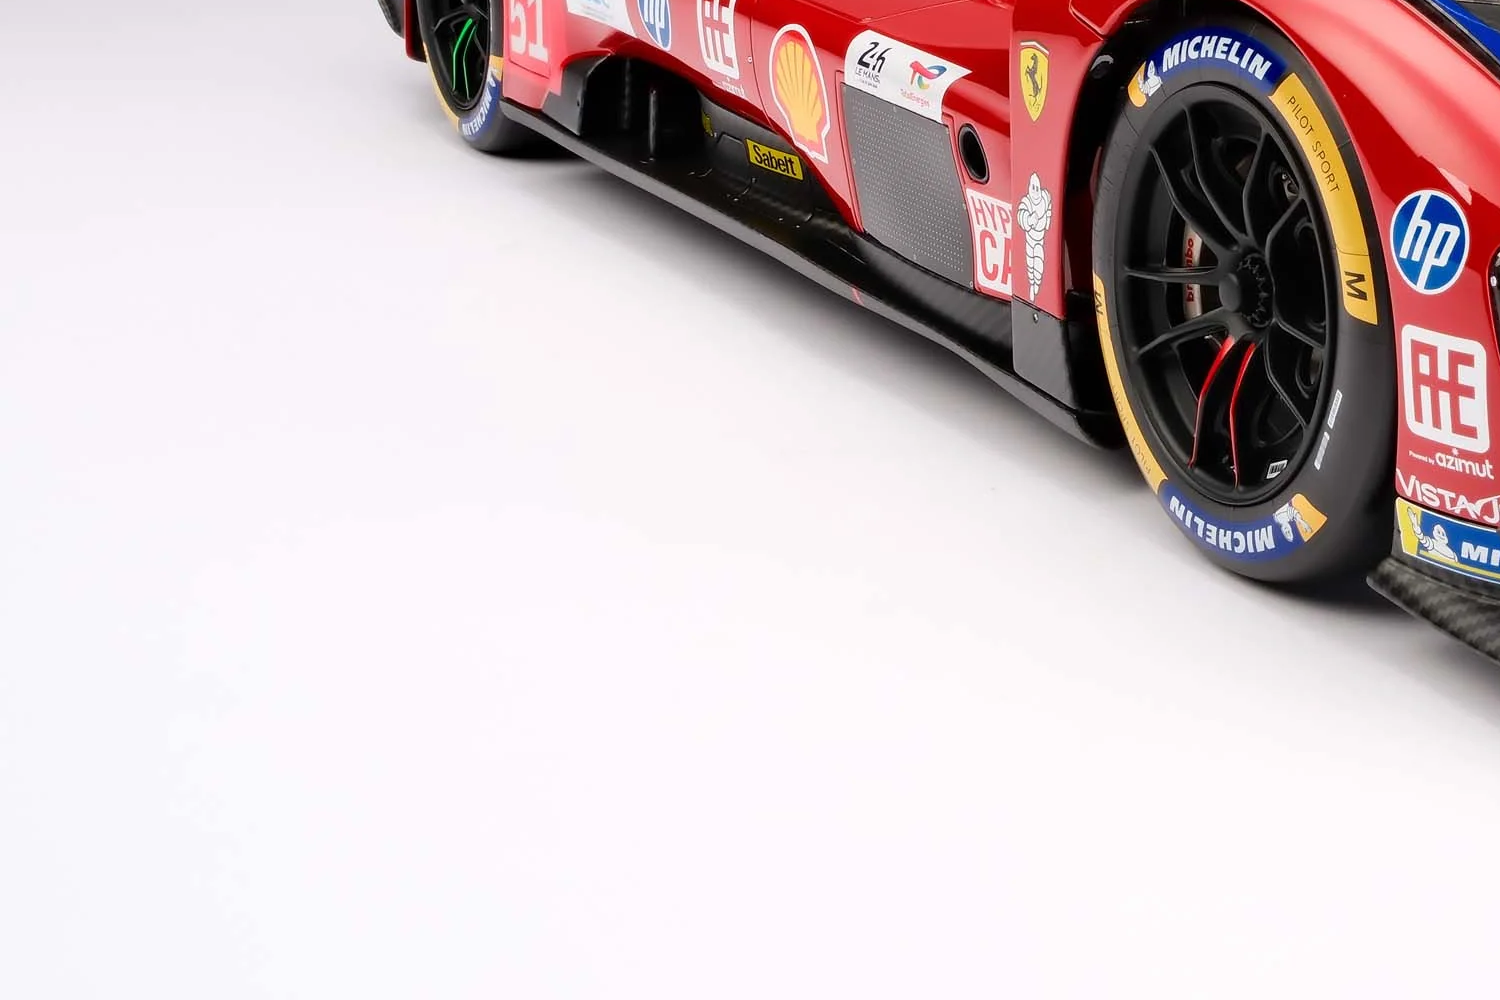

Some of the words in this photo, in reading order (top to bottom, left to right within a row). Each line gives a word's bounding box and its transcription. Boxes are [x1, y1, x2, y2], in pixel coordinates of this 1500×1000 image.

[1162, 35, 1272, 81] MICHELIN
[753, 145, 797, 177] Sabelt
[1287, 95, 1315, 136] PILOT
[1311, 140, 1340, 193] SPORT
[970, 196, 1012, 235] HYP
[1398, 191, 1461, 293] hp
[1344, 271, 1368, 301] M
[1435, 449, 1495, 480] azimut
[1169, 495, 1276, 553] MICHELIN
